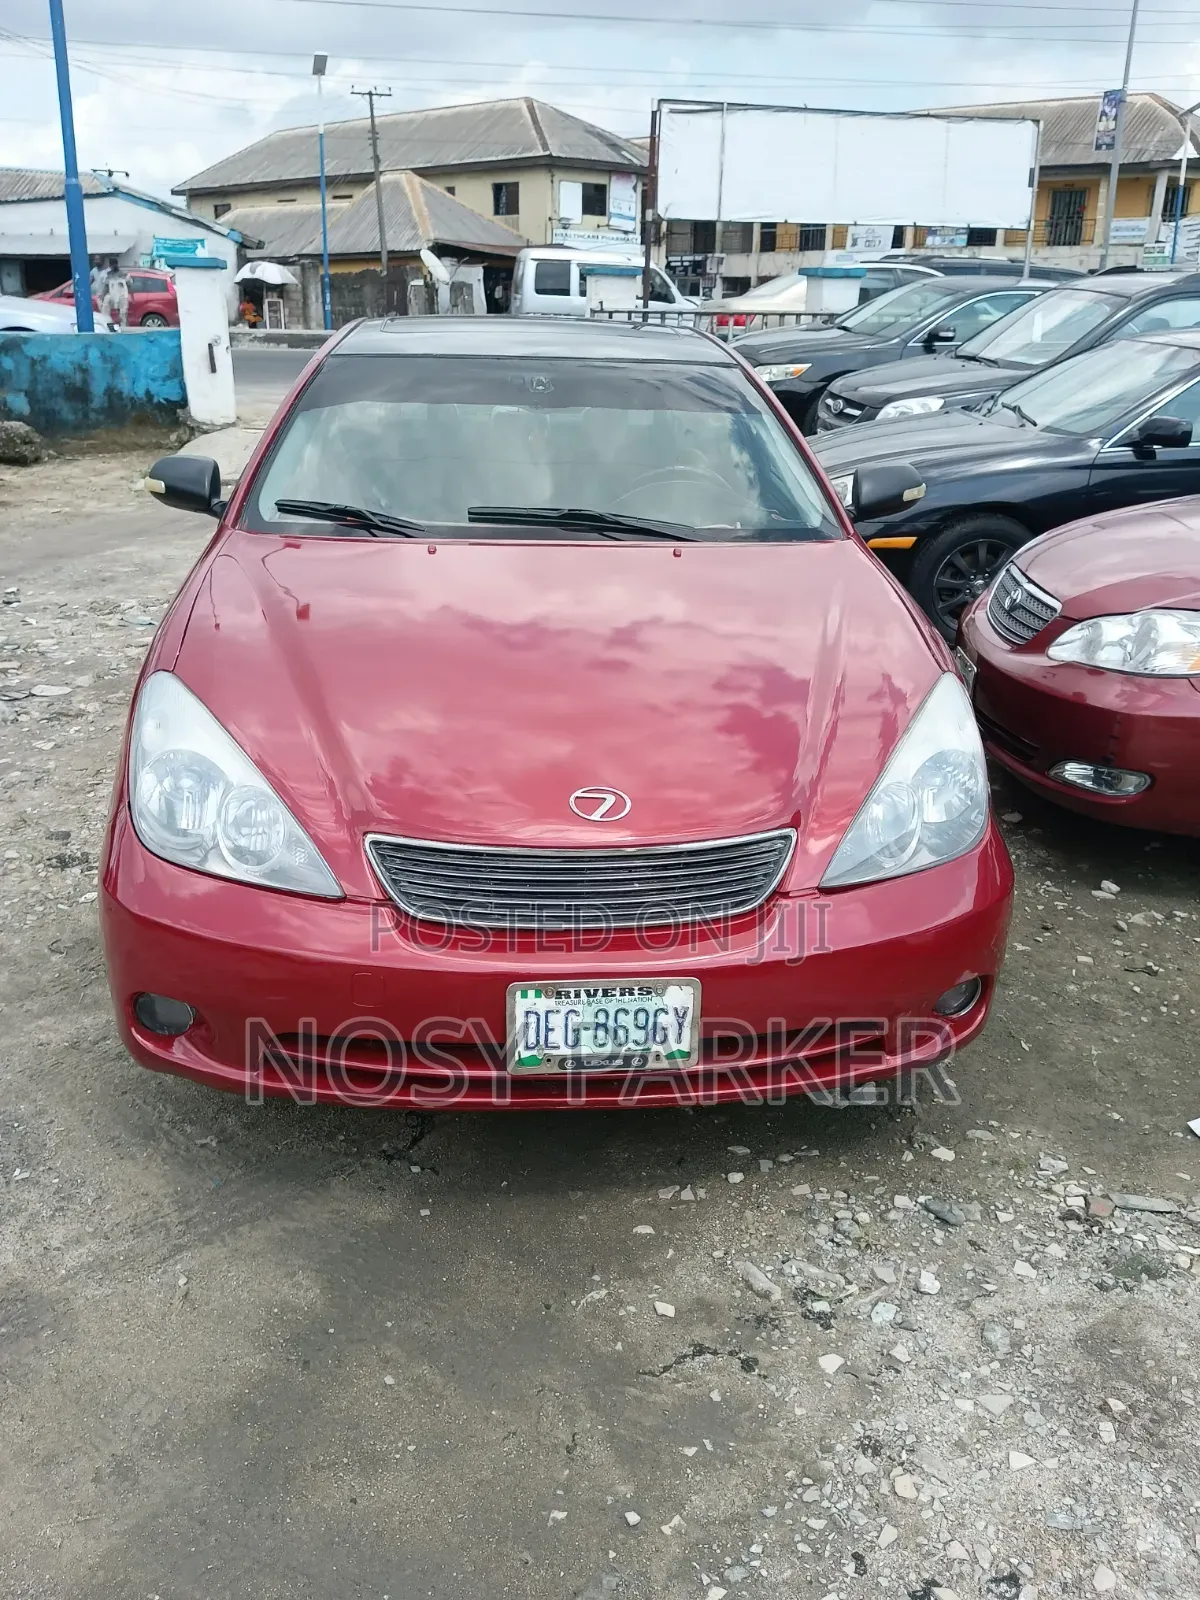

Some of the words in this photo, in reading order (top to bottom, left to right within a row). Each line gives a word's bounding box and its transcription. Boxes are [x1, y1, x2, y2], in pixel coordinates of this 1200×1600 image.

[555, 232, 600, 240] HEALTHCARE
[555, 987, 653, 999] RIVERS
[583, 1059, 624, 1067] LEXUS
